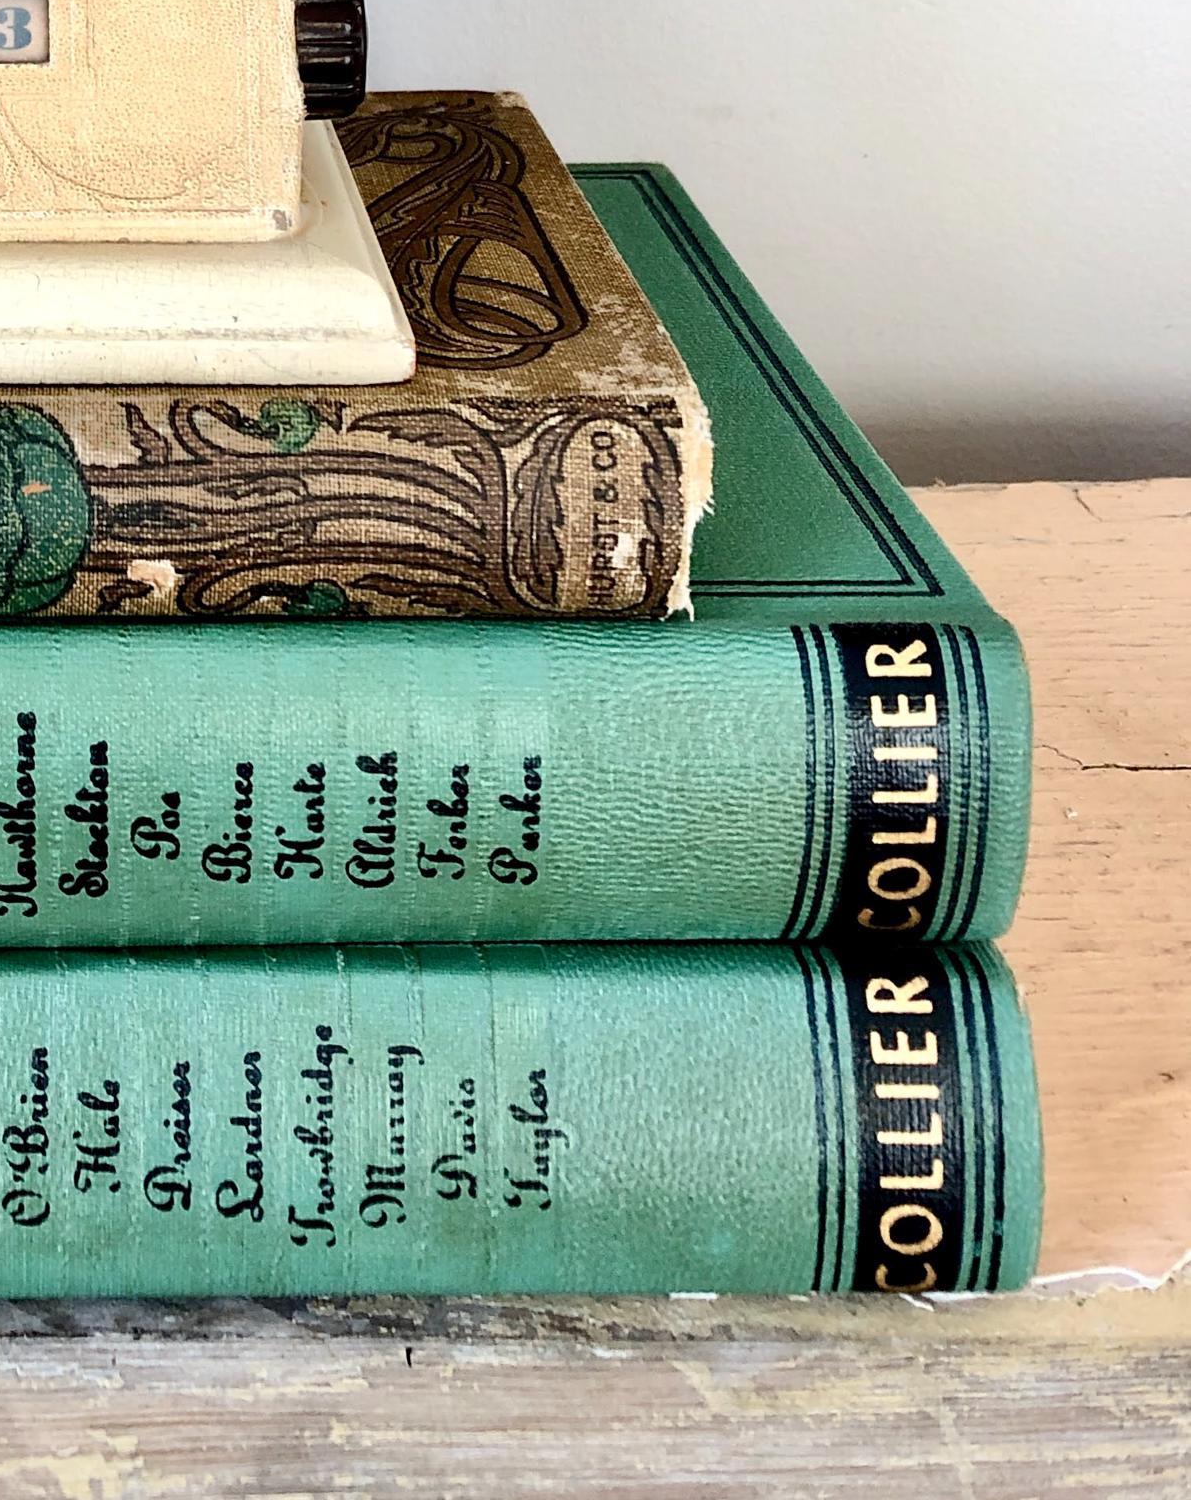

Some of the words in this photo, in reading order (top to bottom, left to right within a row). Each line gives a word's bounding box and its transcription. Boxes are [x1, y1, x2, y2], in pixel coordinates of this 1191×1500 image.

[592, 480, 618, 504] &
[57, 740, 109, 898] Stockton
[130, 791, 181, 860] Poe
[201, 761, 254, 884] Bierce
[273, 761, 327, 880] Harte
[345, 751, 398, 888] Aldrich
[416, 763, 470, 881] Ferber
[487, 754, 542, 886] Parker
[857, 637, 939, 933] COLLIER
[1, 1046, 51, 1227] O'Brien
[72, 1079, 121, 1194] Hale
[143, 1060, 192, 1212] Dreiser
[215, 1050, 264, 1223] Lardner
[287, 1024, 355, 1248] Trowbridge
[358, 1044, 426, 1229] Murray
[430, 1077, 478, 1201] Davis
[502, 1067, 572, 1211] Taylor
[865, 974, 946, 1295] COLLIER
